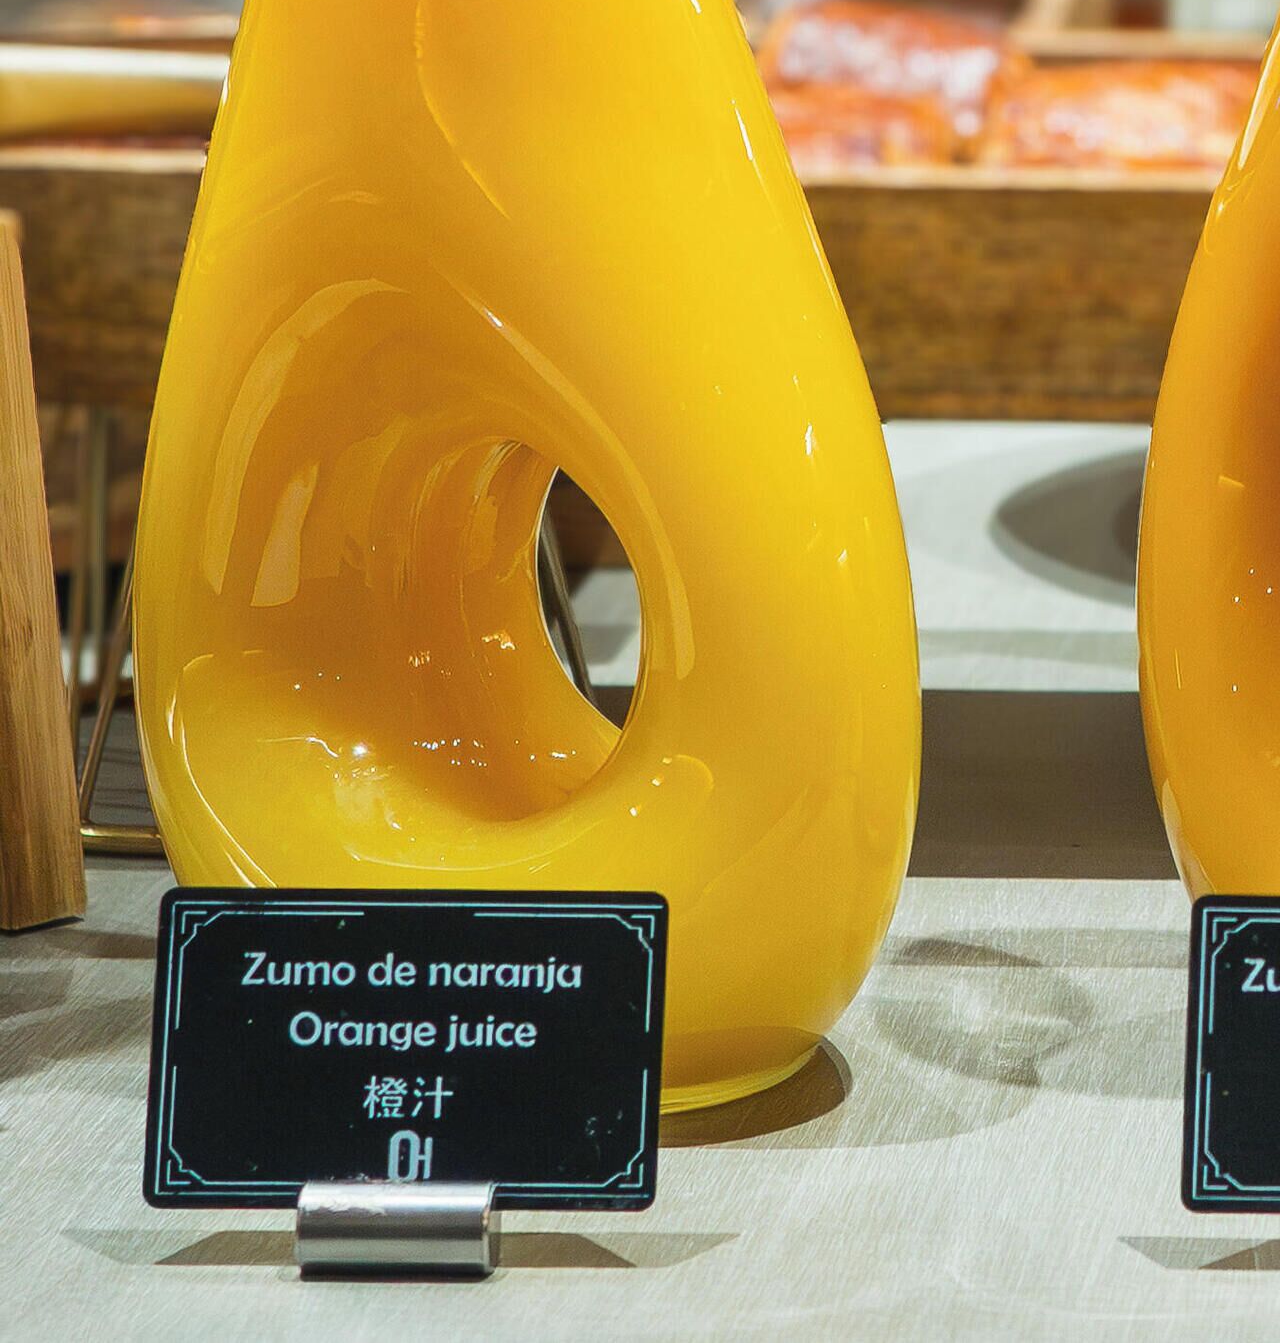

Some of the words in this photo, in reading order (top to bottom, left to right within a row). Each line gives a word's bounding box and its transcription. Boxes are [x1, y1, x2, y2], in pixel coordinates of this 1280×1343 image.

[241, 951, 356, 987] Zumo
[367, 952, 417, 987] de
[428, 956, 582, 994] naranja
[289, 1010, 437, 1052] Orange
[444, 1014, 538, 1053] juice
[362, 1075, 454, 1119] 橙汁
